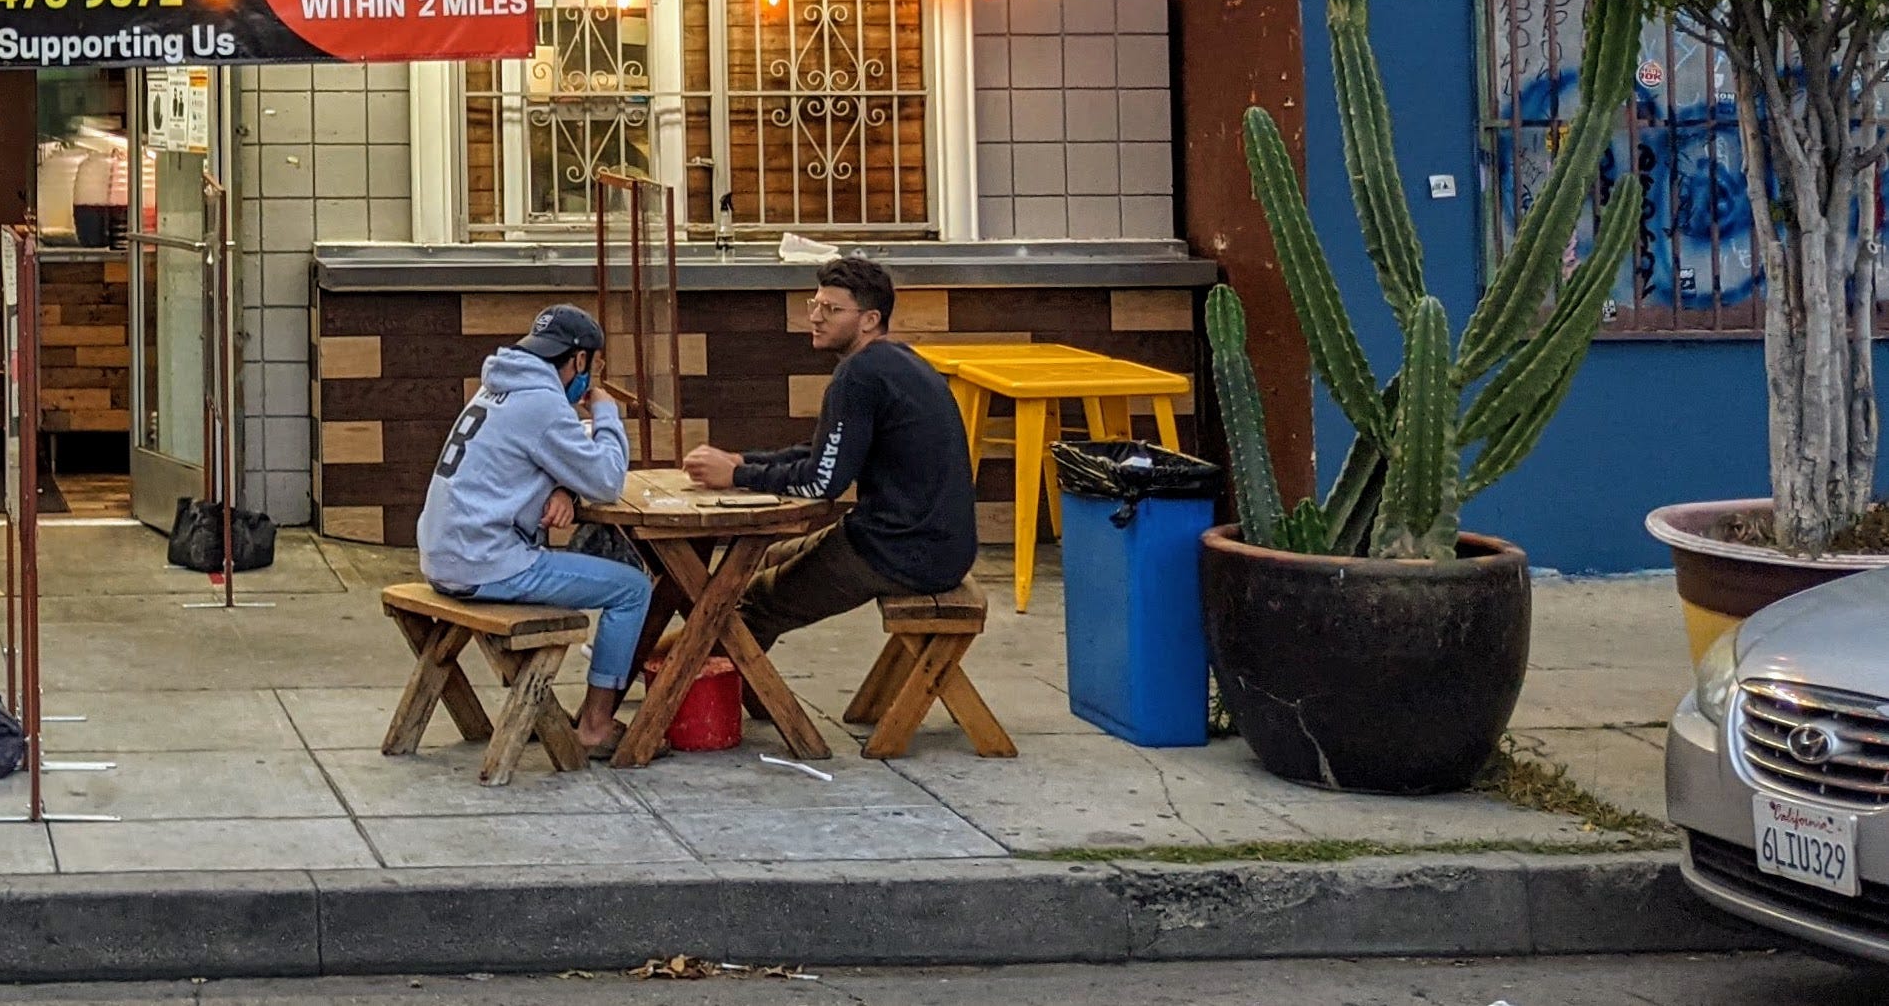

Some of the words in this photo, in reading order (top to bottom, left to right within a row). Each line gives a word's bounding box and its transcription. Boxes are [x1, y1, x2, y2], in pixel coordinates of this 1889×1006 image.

[192, 23, 235, 57] Us
[436, 404, 488, 479] 8
[1771, 802, 1830, 832] California
[1762, 826, 1846, 880] 6LIU329
